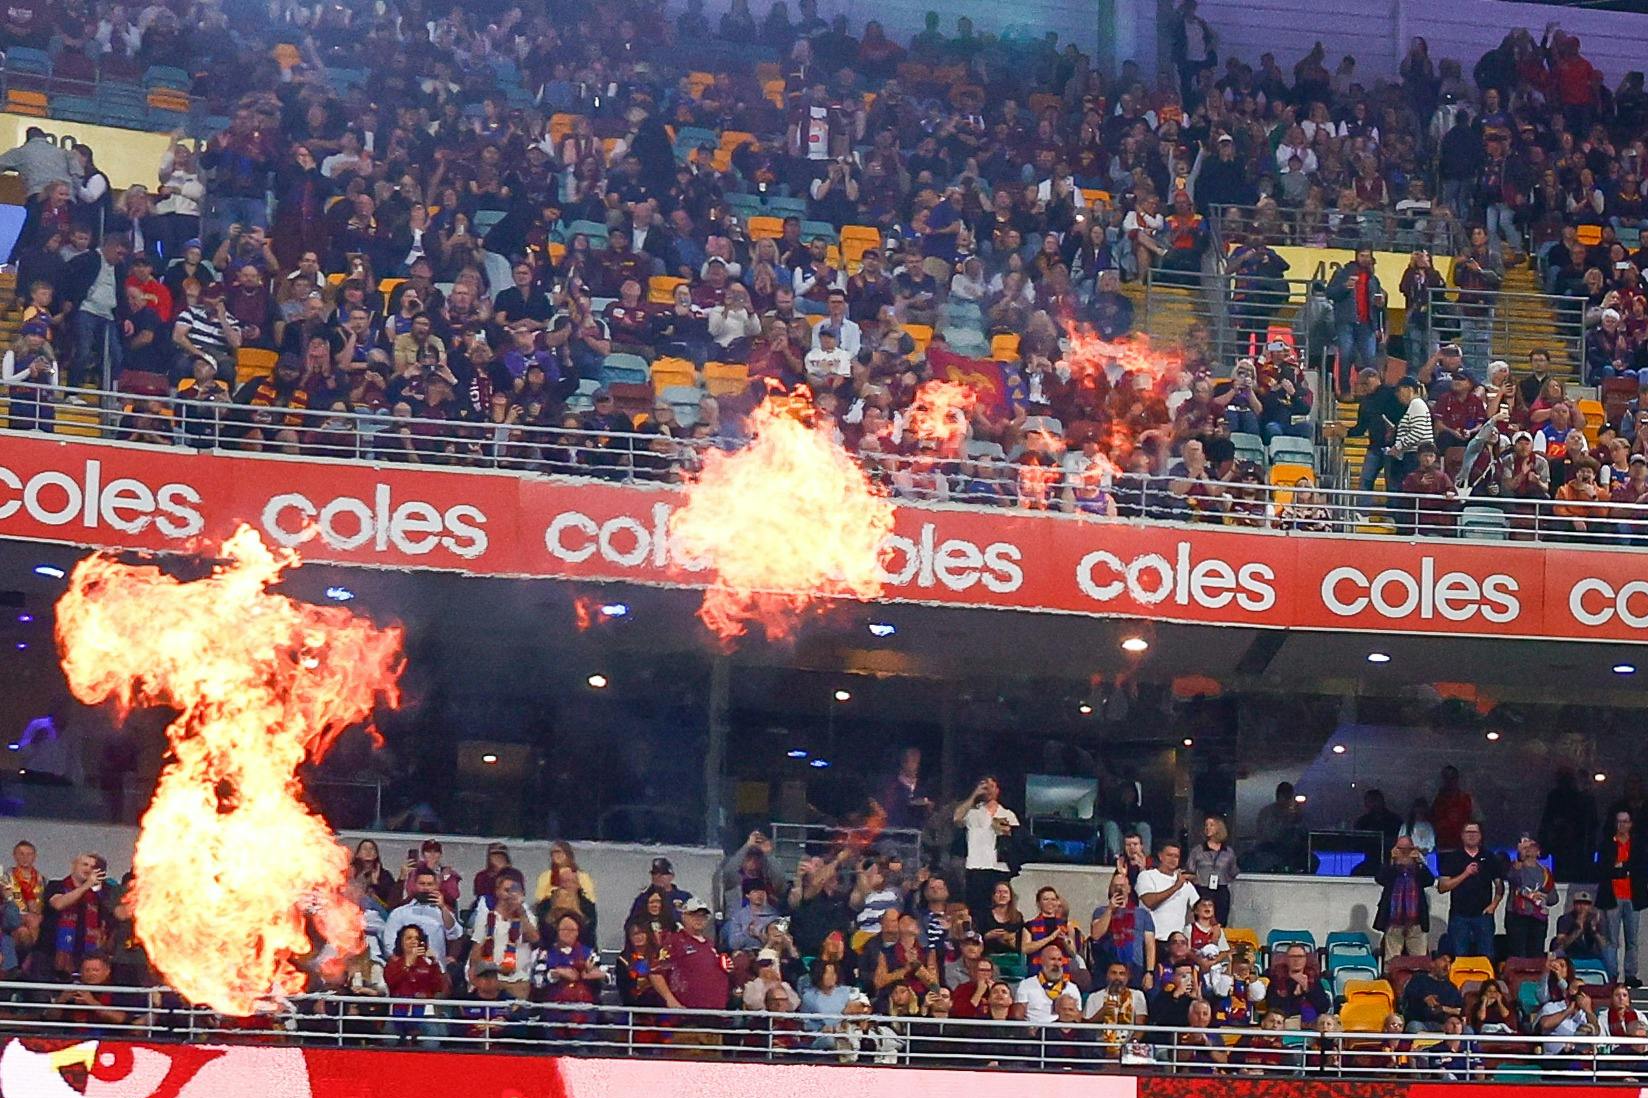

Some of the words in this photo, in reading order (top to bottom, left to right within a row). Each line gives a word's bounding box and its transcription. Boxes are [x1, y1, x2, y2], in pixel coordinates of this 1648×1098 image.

[261, 484, 488, 559] coles
[878, 523, 1023, 593] oles
[1077, 542, 1275, 611] coles
[1322, 557, 1519, 622] coles
